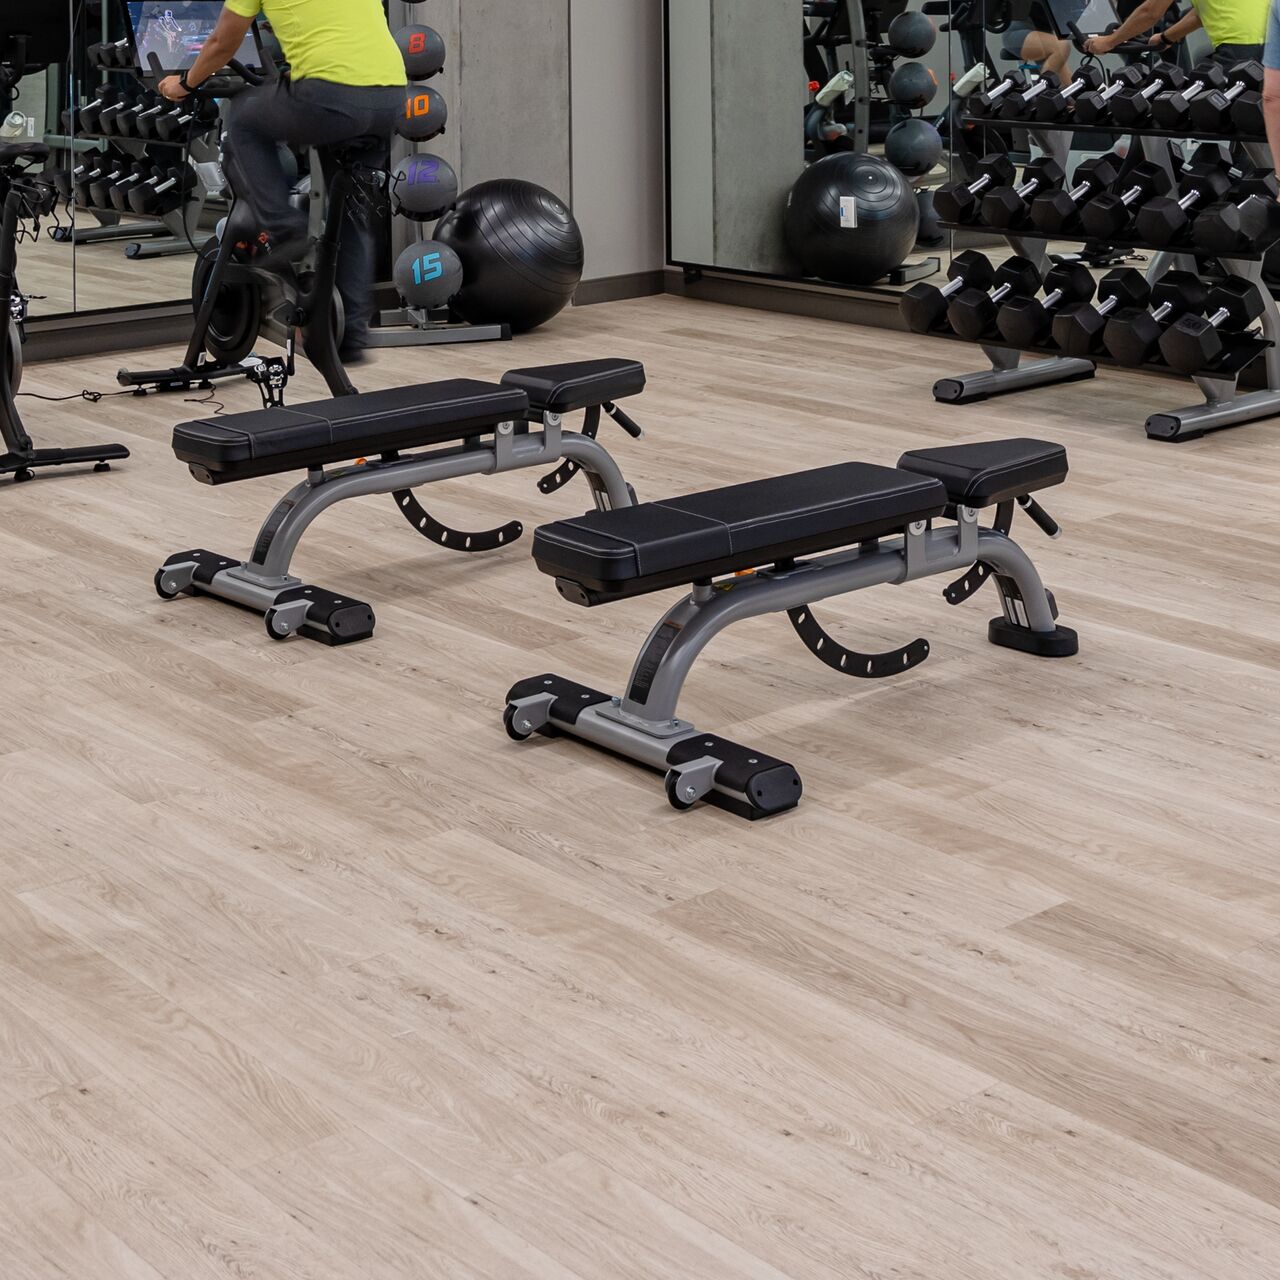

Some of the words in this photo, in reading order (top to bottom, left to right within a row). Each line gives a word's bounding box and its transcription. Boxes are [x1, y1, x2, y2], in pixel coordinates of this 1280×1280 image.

[408, 32, 426, 54] 8
[405, 94, 429, 119] 10
[407, 160, 439, 186] 12
[412, 252, 442, 285] 15
